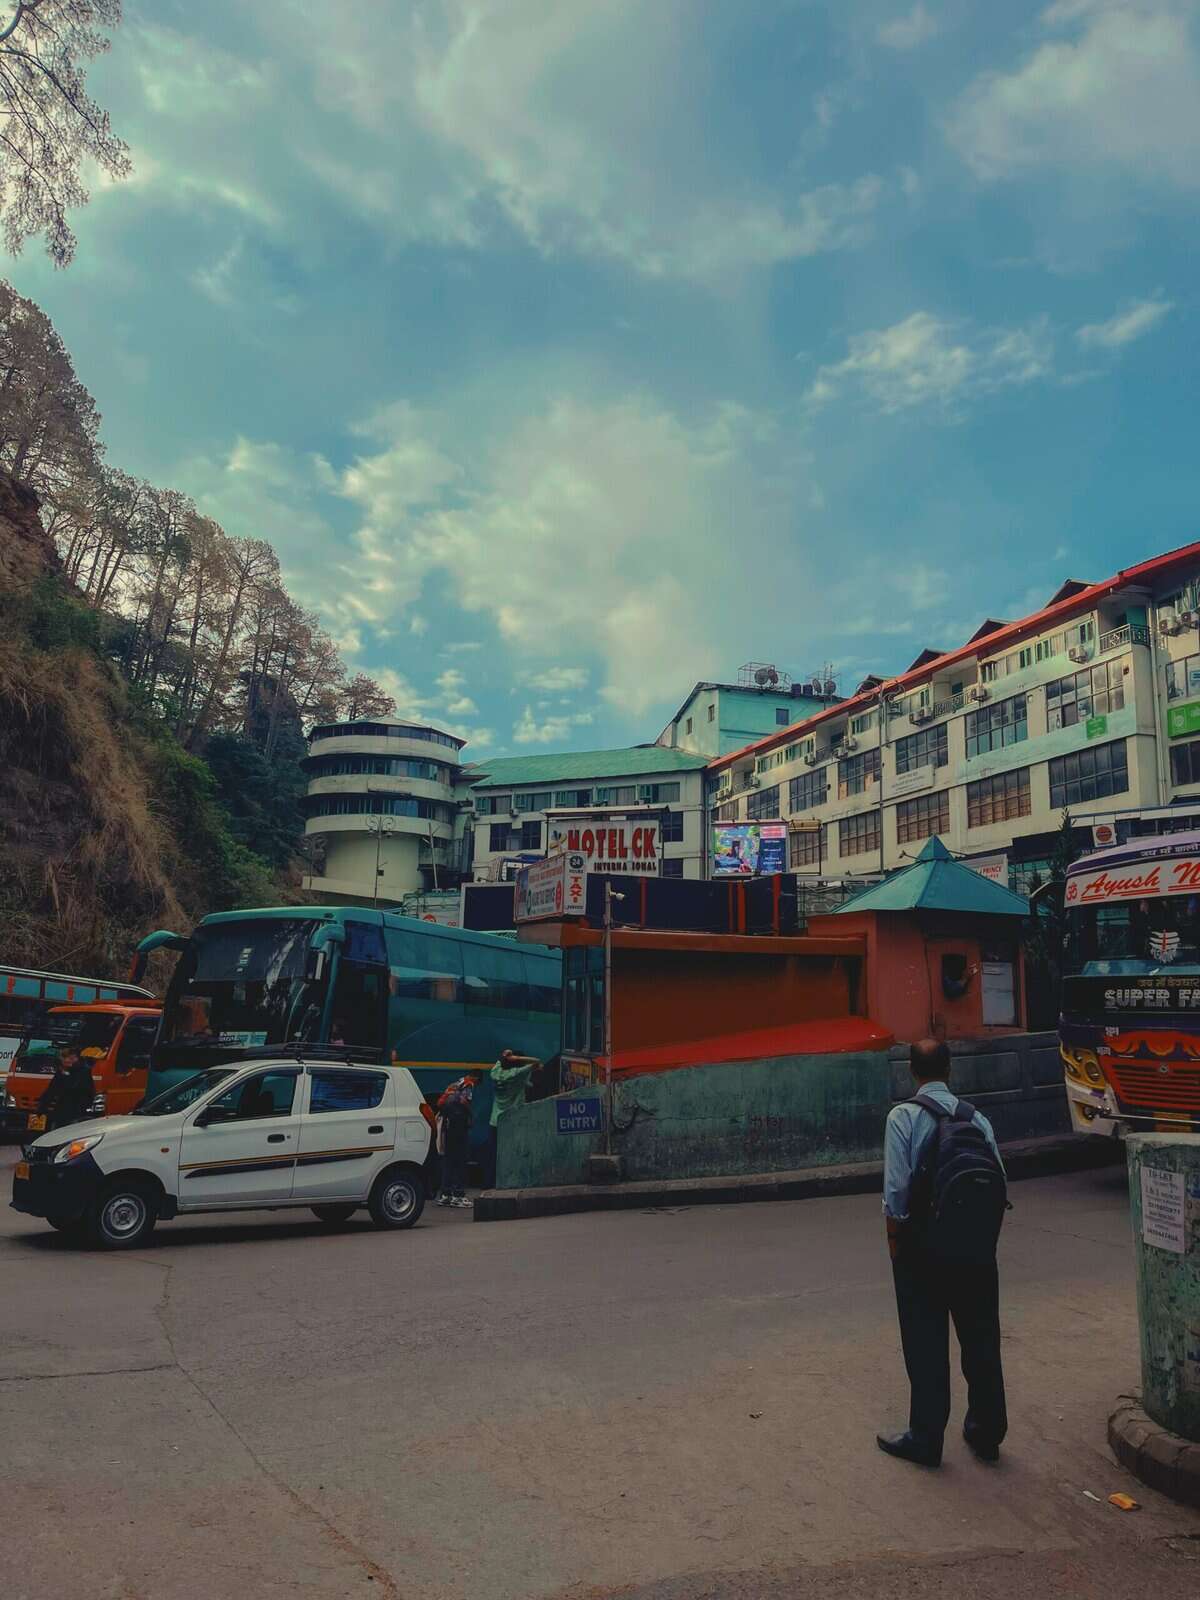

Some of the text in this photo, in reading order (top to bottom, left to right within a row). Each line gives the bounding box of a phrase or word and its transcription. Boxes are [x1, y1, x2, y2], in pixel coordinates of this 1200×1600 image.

[567, 827, 656, 858] HOTEL CK
[569, 876, 582, 903] TAXI
[1081, 866, 1161, 897] Ayush
[1104, 989, 1170, 1007] SUPER
[569, 1102, 586, 1115] NO
[559, 1116, 598, 1129] ENTRY
